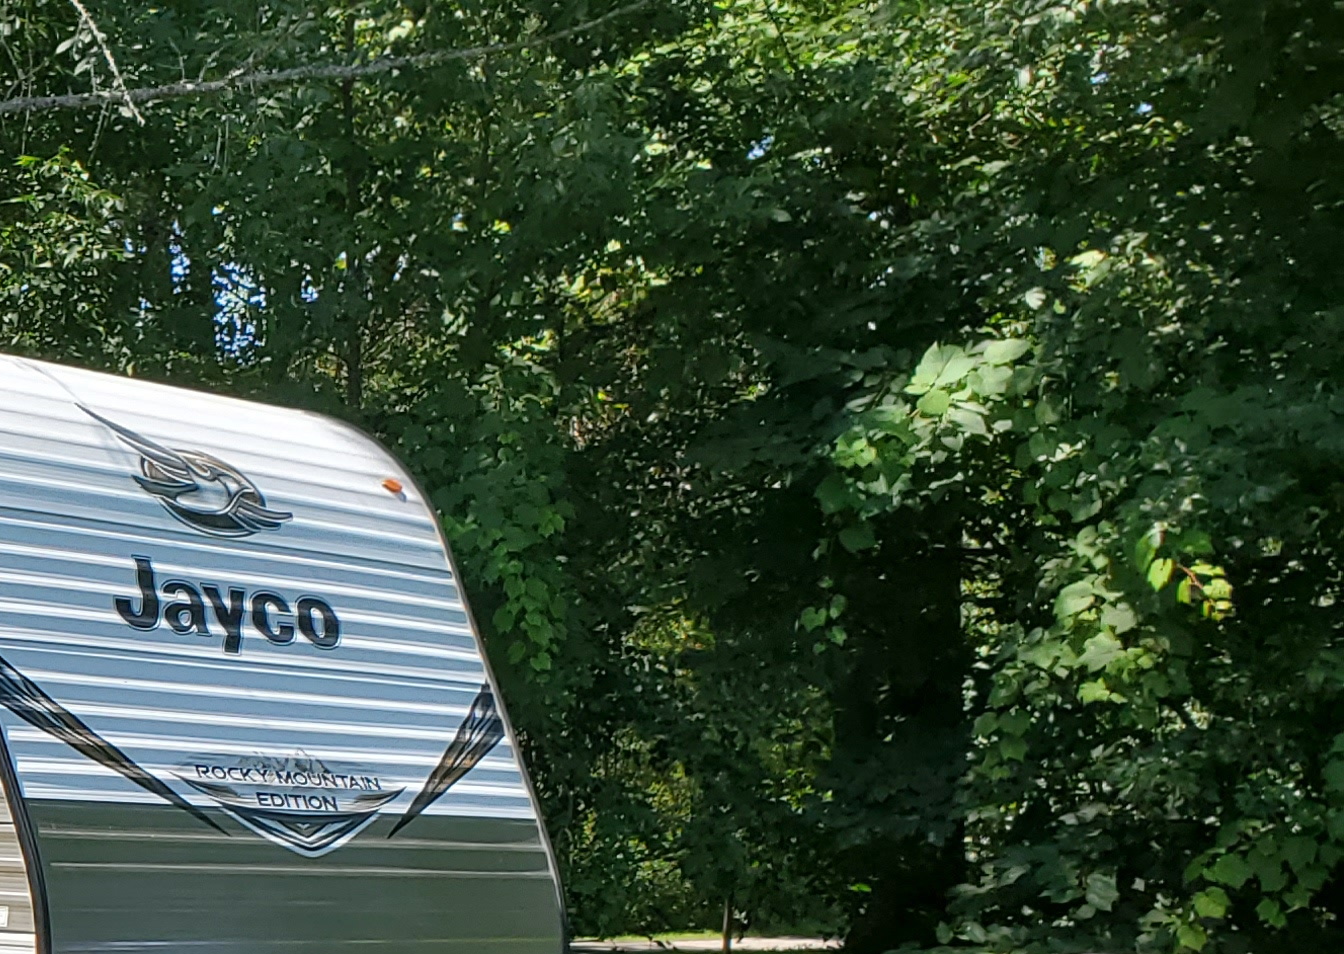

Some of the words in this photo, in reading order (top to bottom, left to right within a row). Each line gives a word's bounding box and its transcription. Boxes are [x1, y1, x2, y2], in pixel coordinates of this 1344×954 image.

[113, 554, 342, 656] Jayco
[194, 764, 270, 783] ROCKY
[275, 771, 383, 791] MOUNTAIN
[255, 791, 339, 811] EDITION
